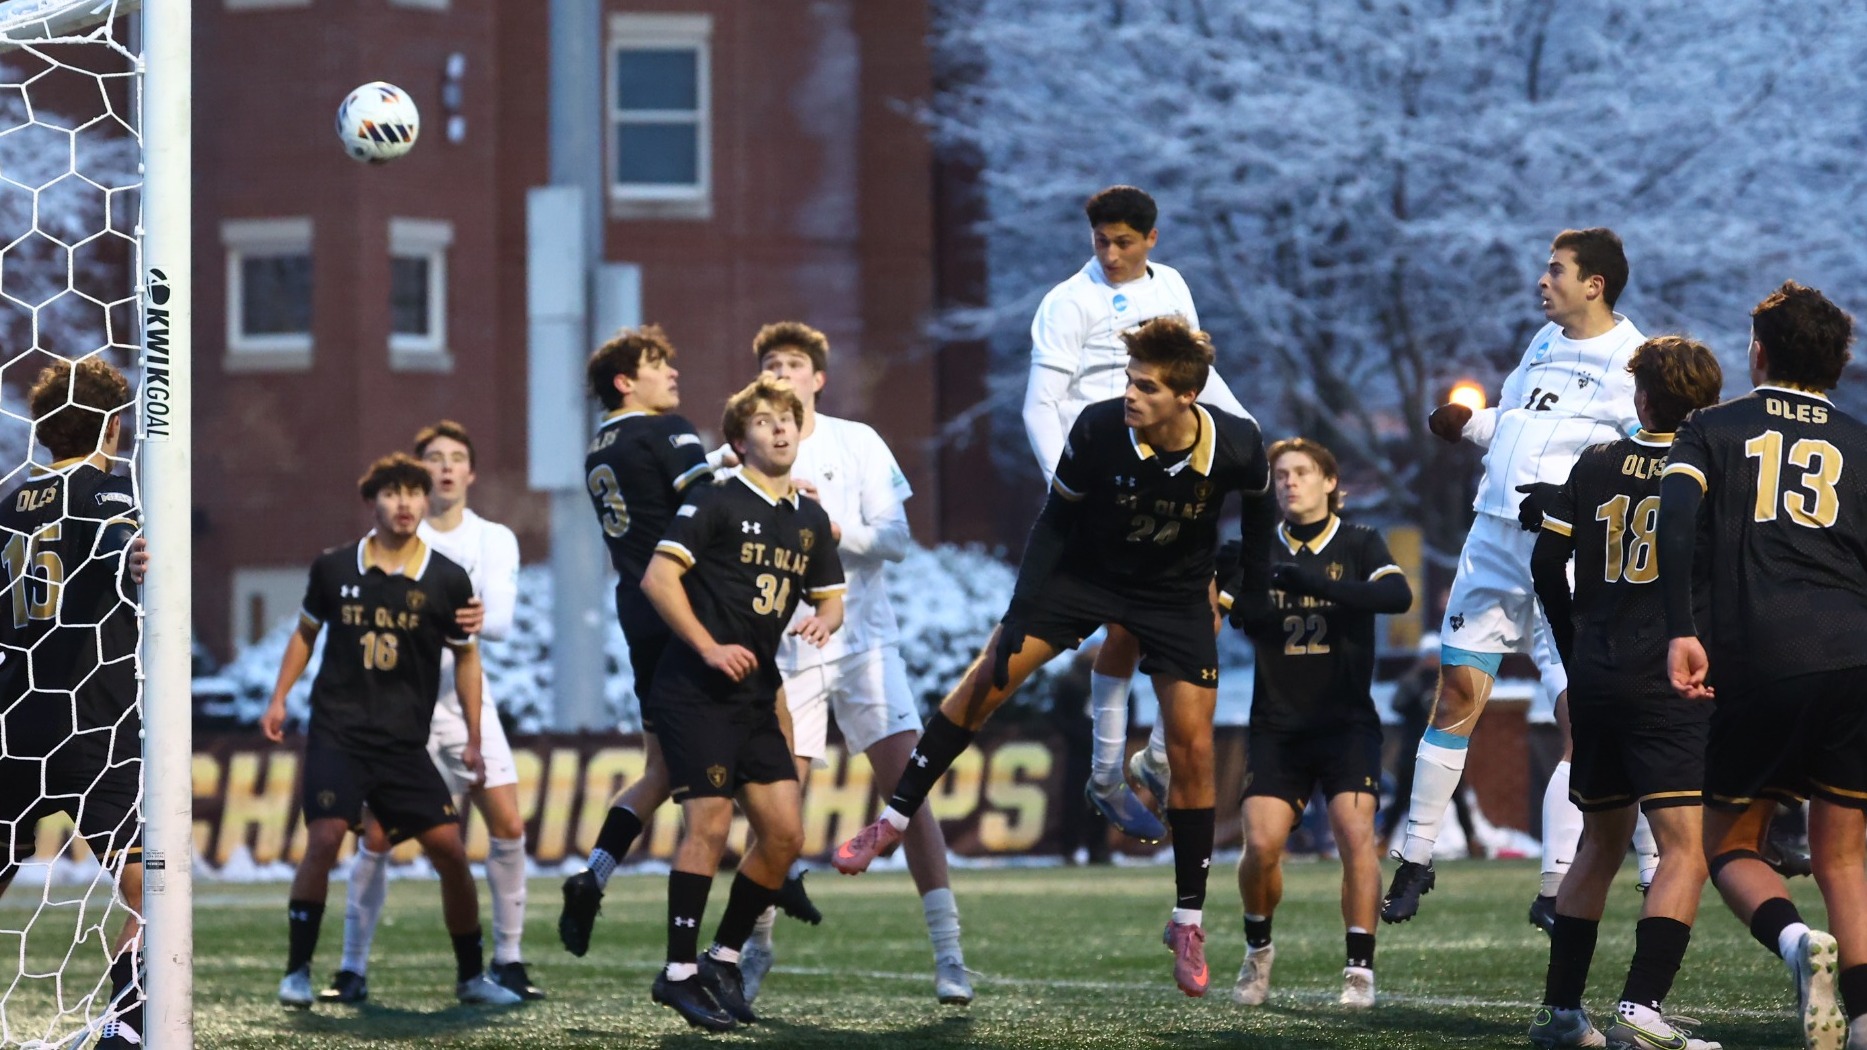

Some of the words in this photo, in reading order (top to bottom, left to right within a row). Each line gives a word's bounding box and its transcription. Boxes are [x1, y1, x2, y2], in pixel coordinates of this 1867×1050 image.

[147, 307, 170, 438] KWIKGOAL
[1766, 397, 1828, 424] OLES
[588, 463, 630, 538] 3
[1745, 429, 1843, 529] 13
[740, 541, 770, 567] ST.
[774, 547, 809, 576] OLAF
[1595, 494, 1661, 584] 18
[1, 522, 64, 629] 15
[752, 573, 790, 618] 34
[360, 631, 397, 670] 16
[1283, 614, 1330, 655] 22
